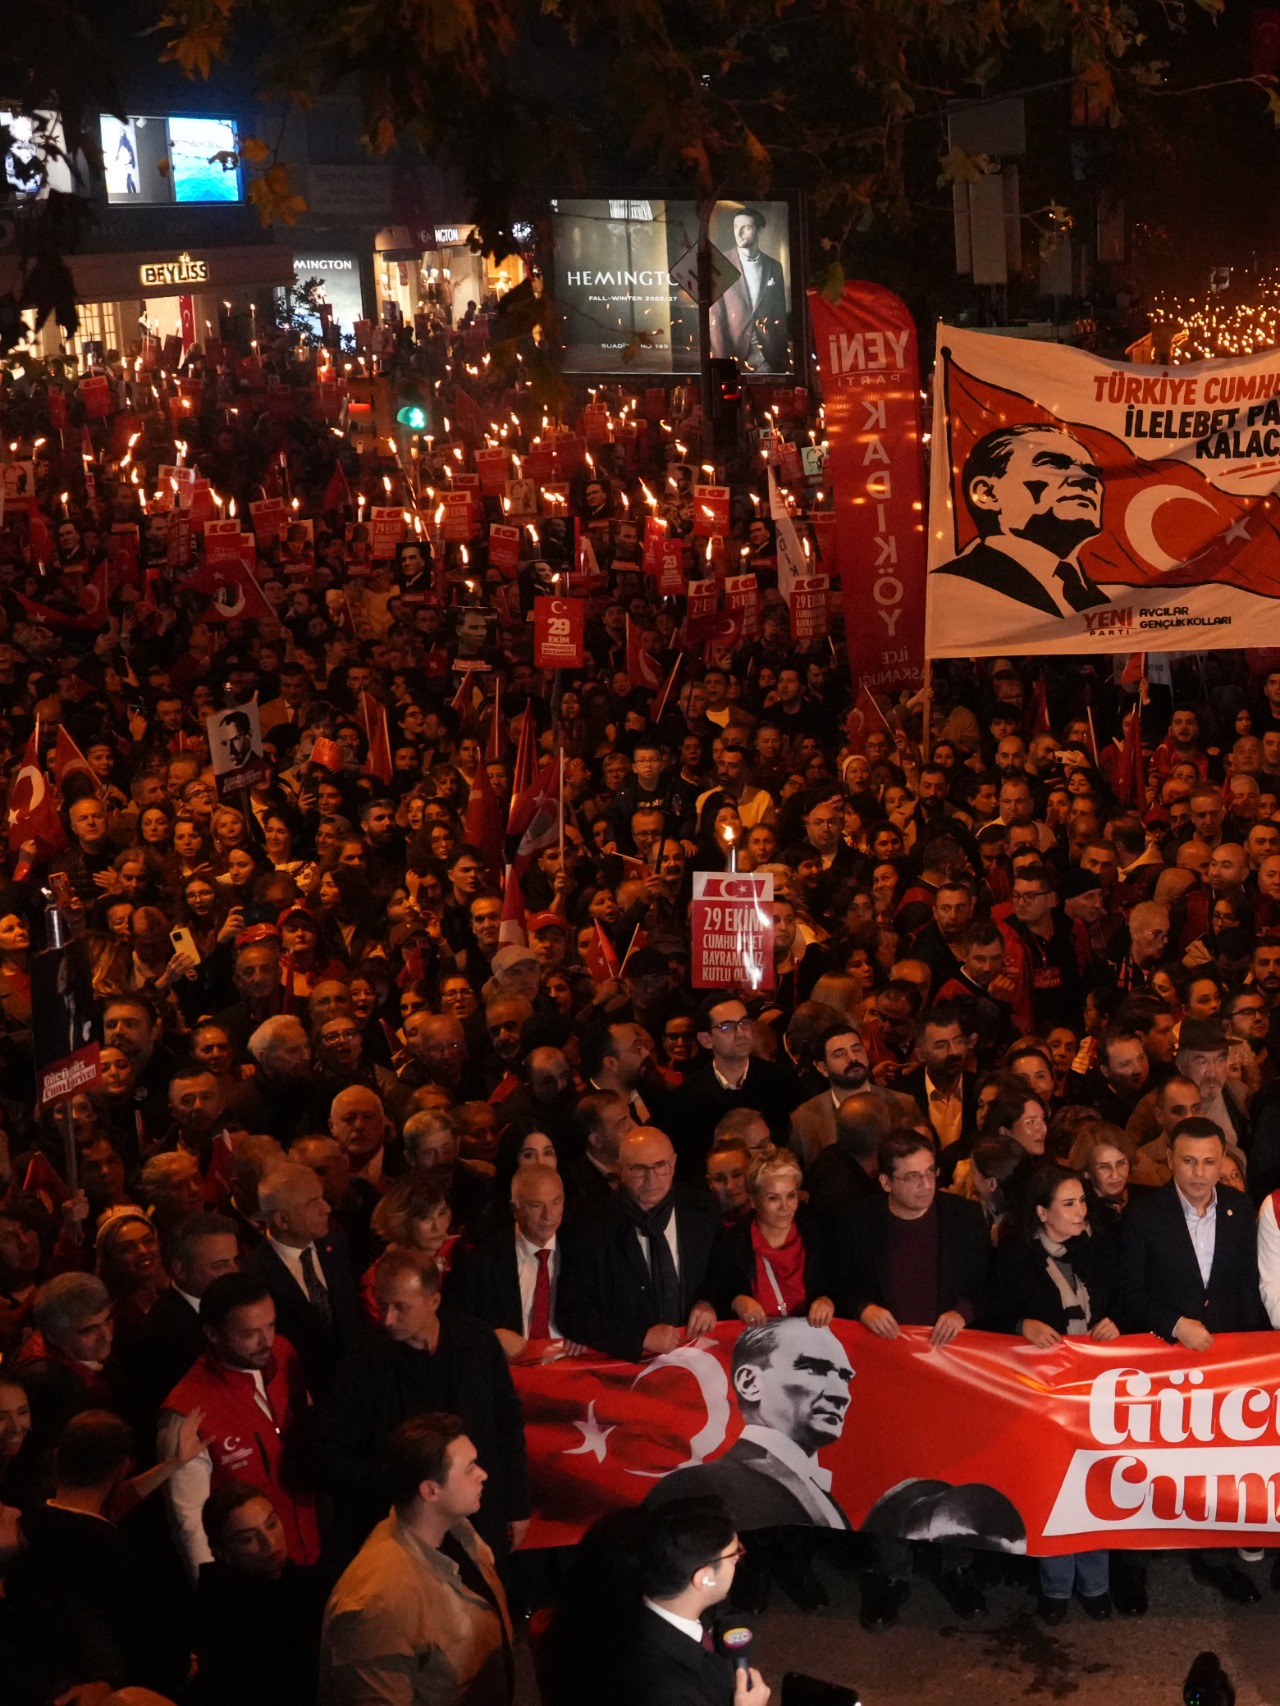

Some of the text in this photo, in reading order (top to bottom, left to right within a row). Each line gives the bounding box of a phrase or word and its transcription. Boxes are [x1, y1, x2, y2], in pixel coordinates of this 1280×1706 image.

[1093, 371, 1198, 405] TÜRKİYE
[1124, 404, 1240, 439] İLELEBET
[1082, 607, 1133, 629] YENİ
[1139, 606, 1189, 618] AVCILAR
[547, 617, 571, 636] 29
[1139, 616, 1232, 631] GENÇLİK KOLLARI
[703, 905, 764, 931] 29 EKİM
[702, 966, 731, 982] KUTLU
